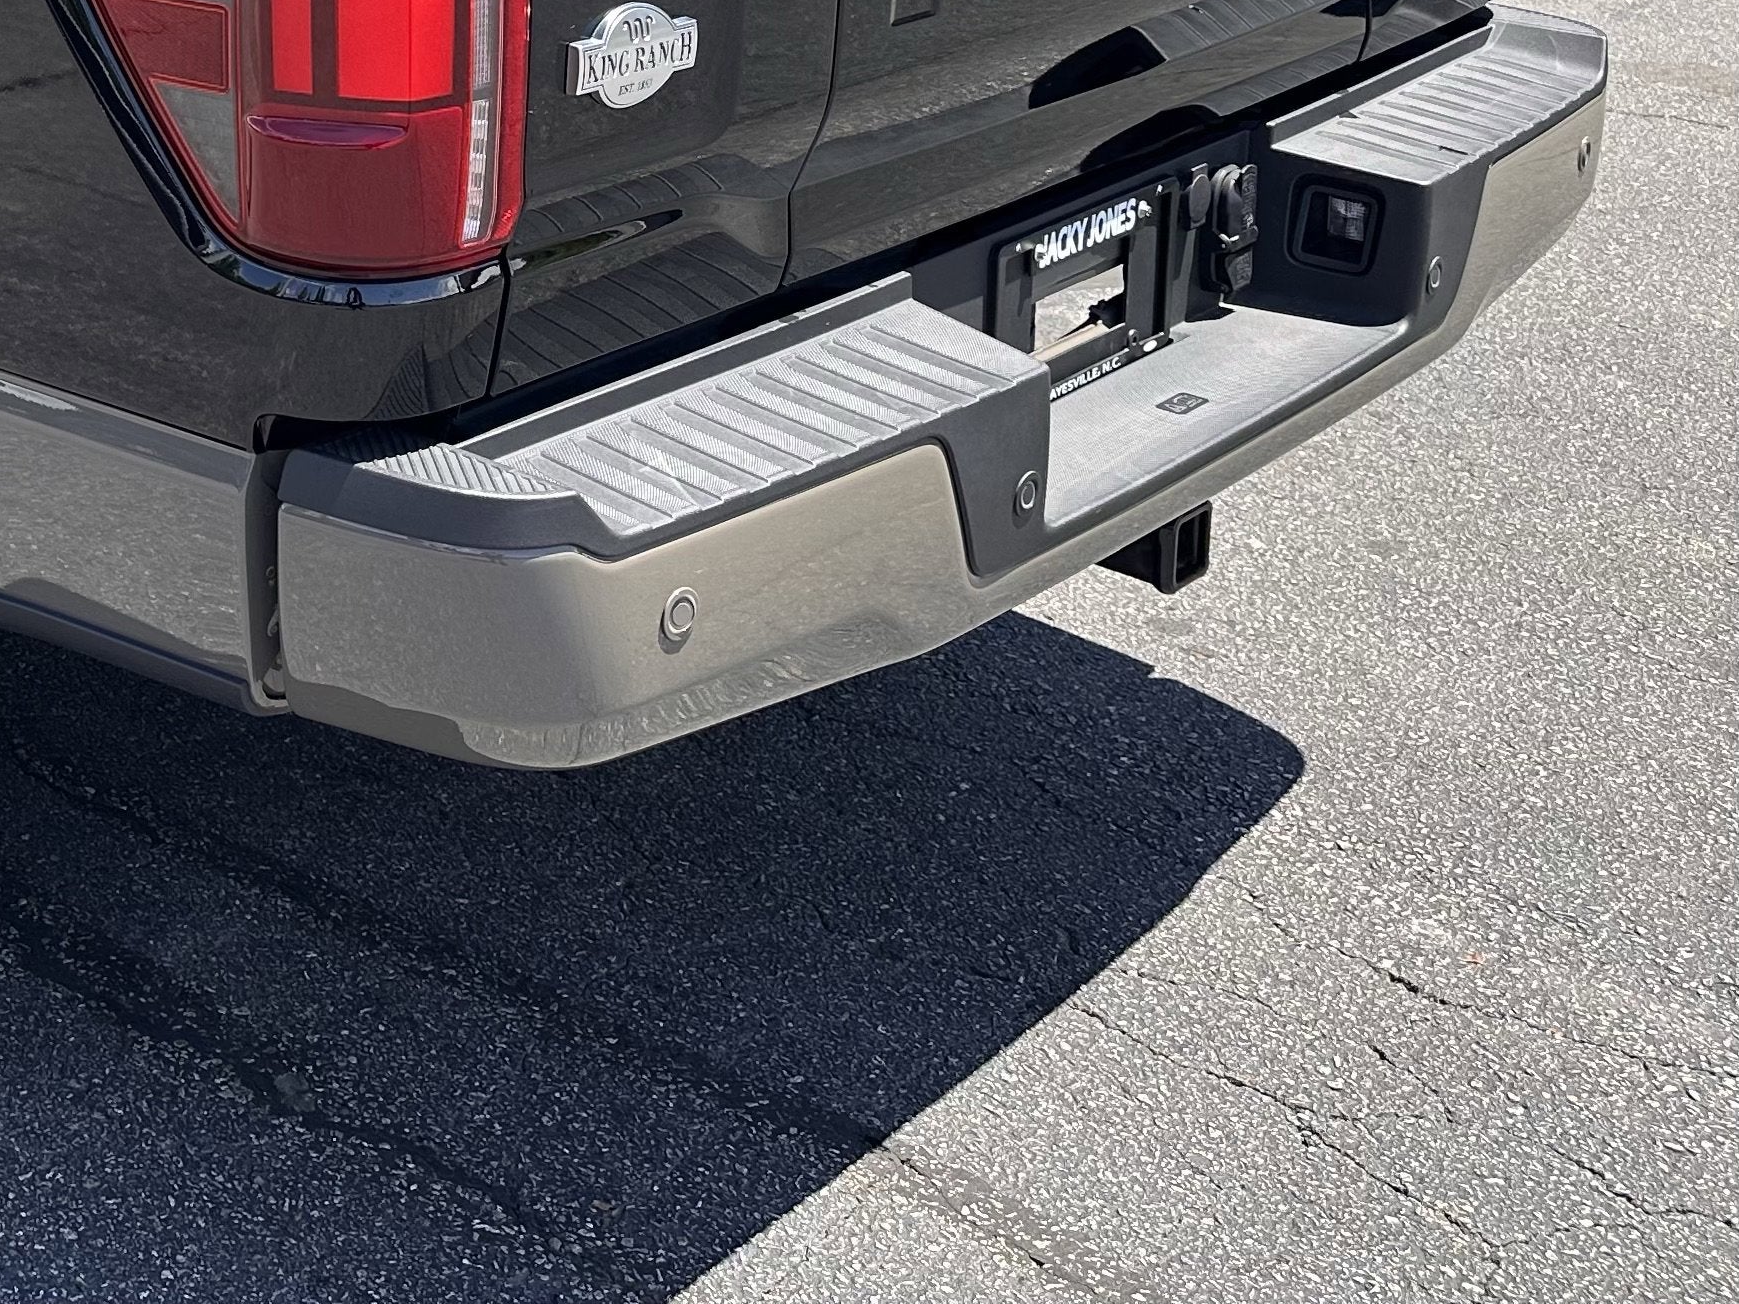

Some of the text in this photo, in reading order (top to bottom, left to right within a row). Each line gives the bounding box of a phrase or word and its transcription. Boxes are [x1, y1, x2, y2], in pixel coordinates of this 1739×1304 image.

[586, 31, 693, 85] KING RANCH
[1038, 197, 1137, 269] JACKY JONES
[1049, 367, 1101, 401] AYESVILLE,
